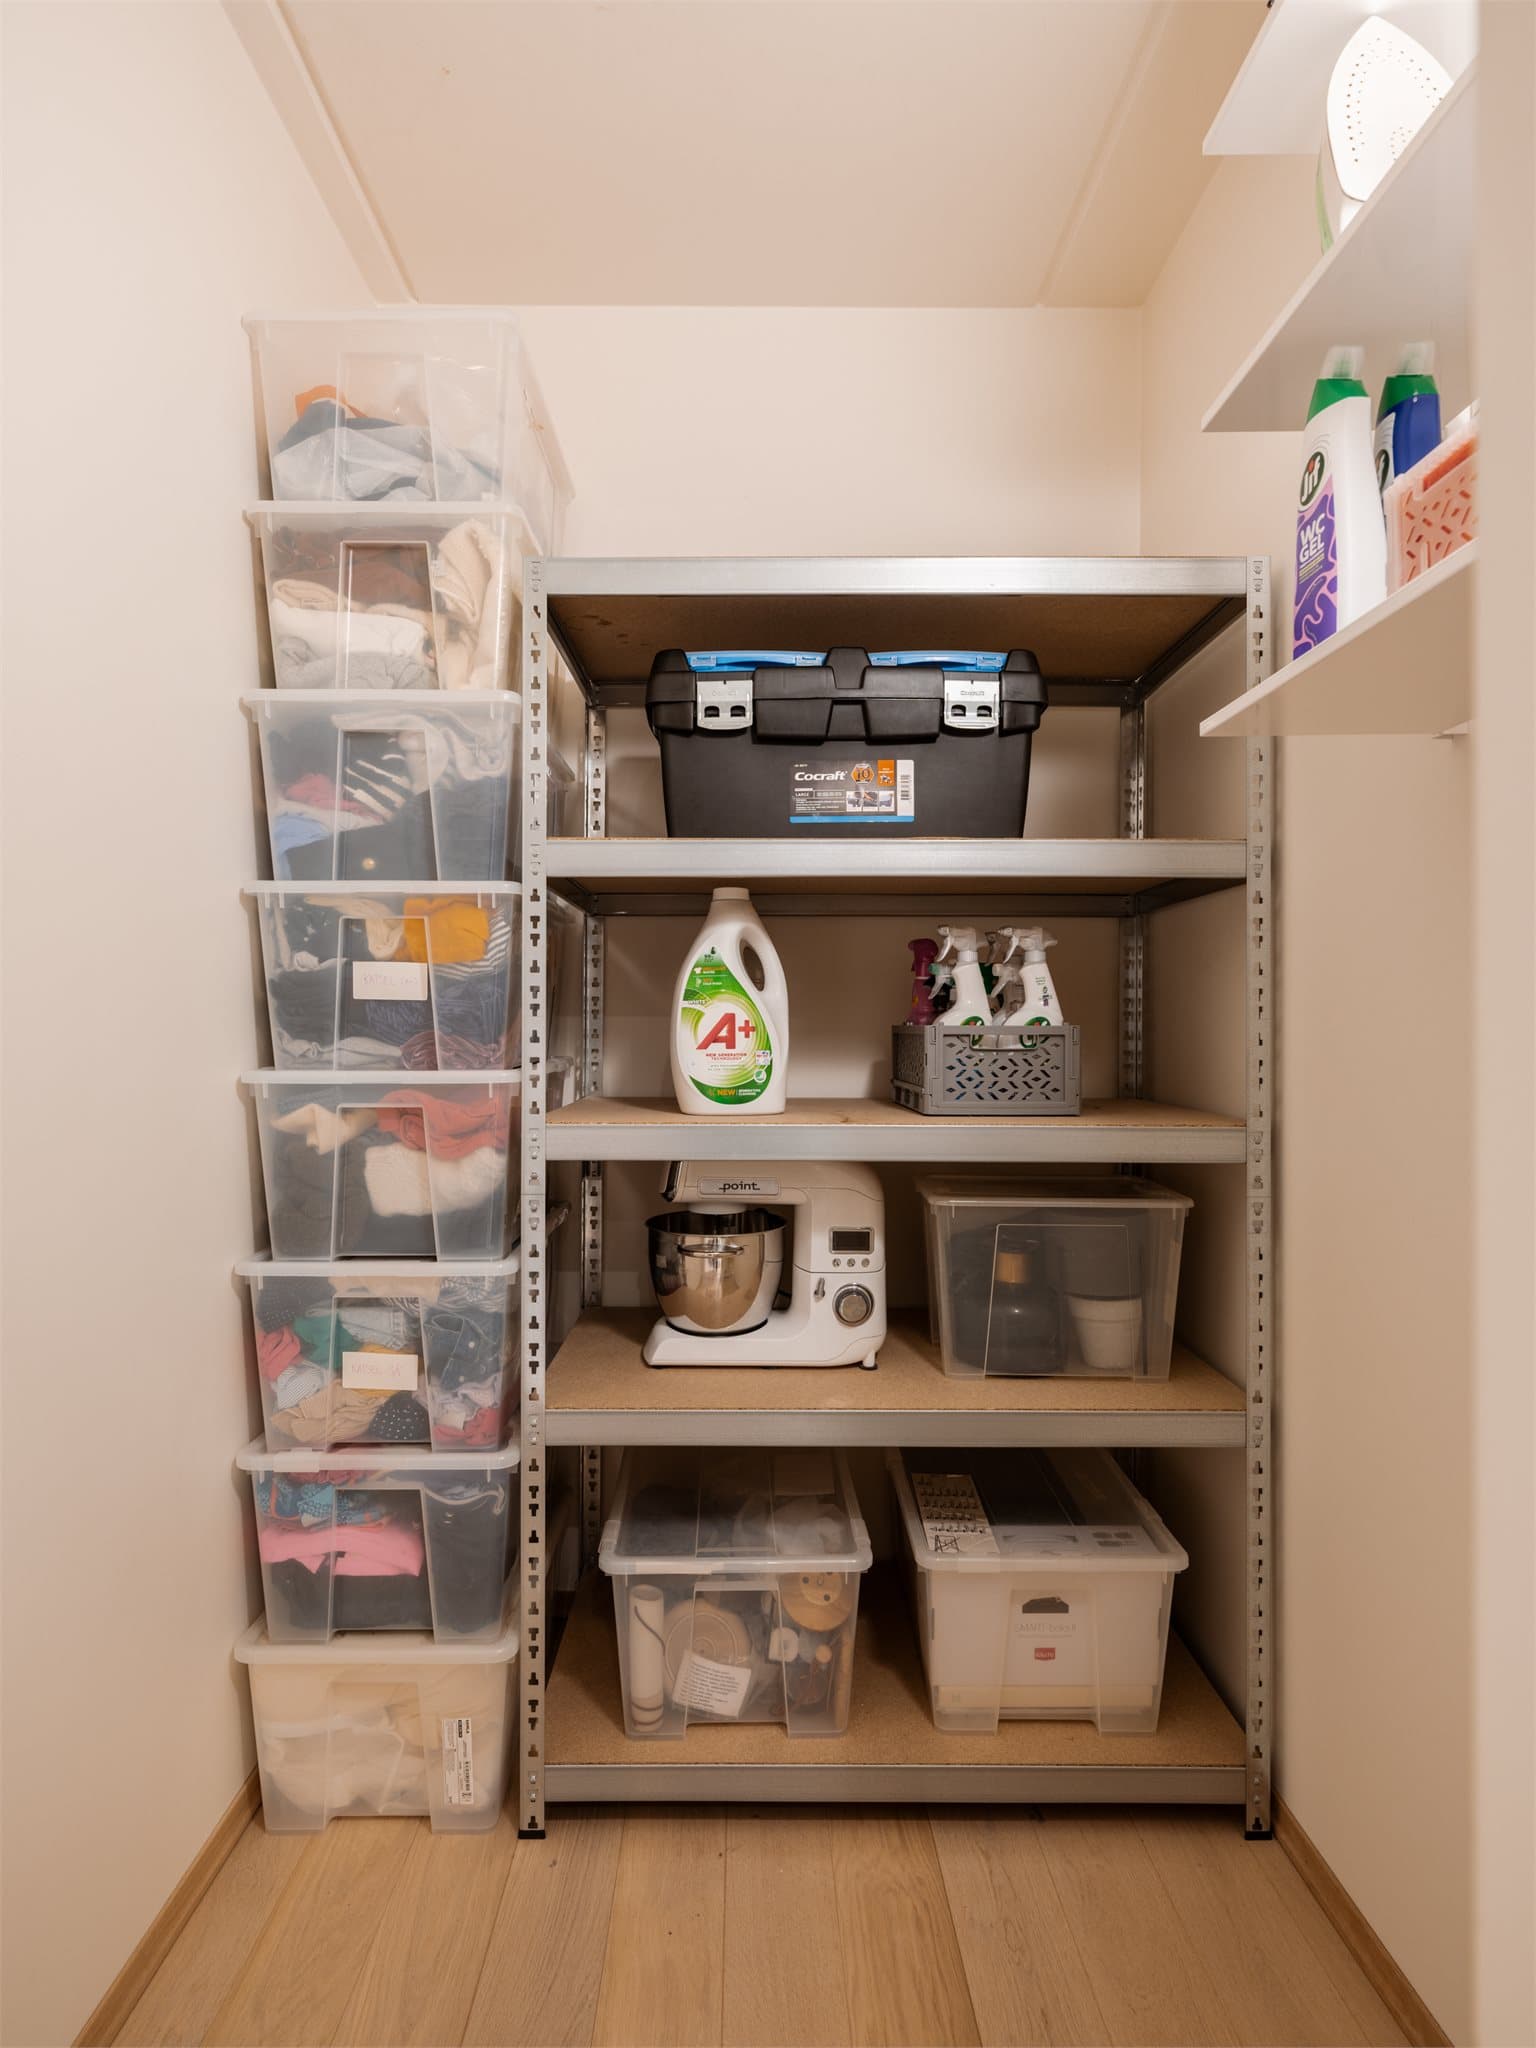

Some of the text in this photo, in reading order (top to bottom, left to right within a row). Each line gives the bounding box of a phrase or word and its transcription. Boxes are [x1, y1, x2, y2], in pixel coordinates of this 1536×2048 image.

[1300, 513, 1326, 547] WC
[1300, 533, 1325, 564] GEL
[794, 770, 846, 781] Cocraft
[696, 1012, 756, 1050] A+
[717, 1088, 734, 1096] NEW
[718, 1180, 761, 1193] point
